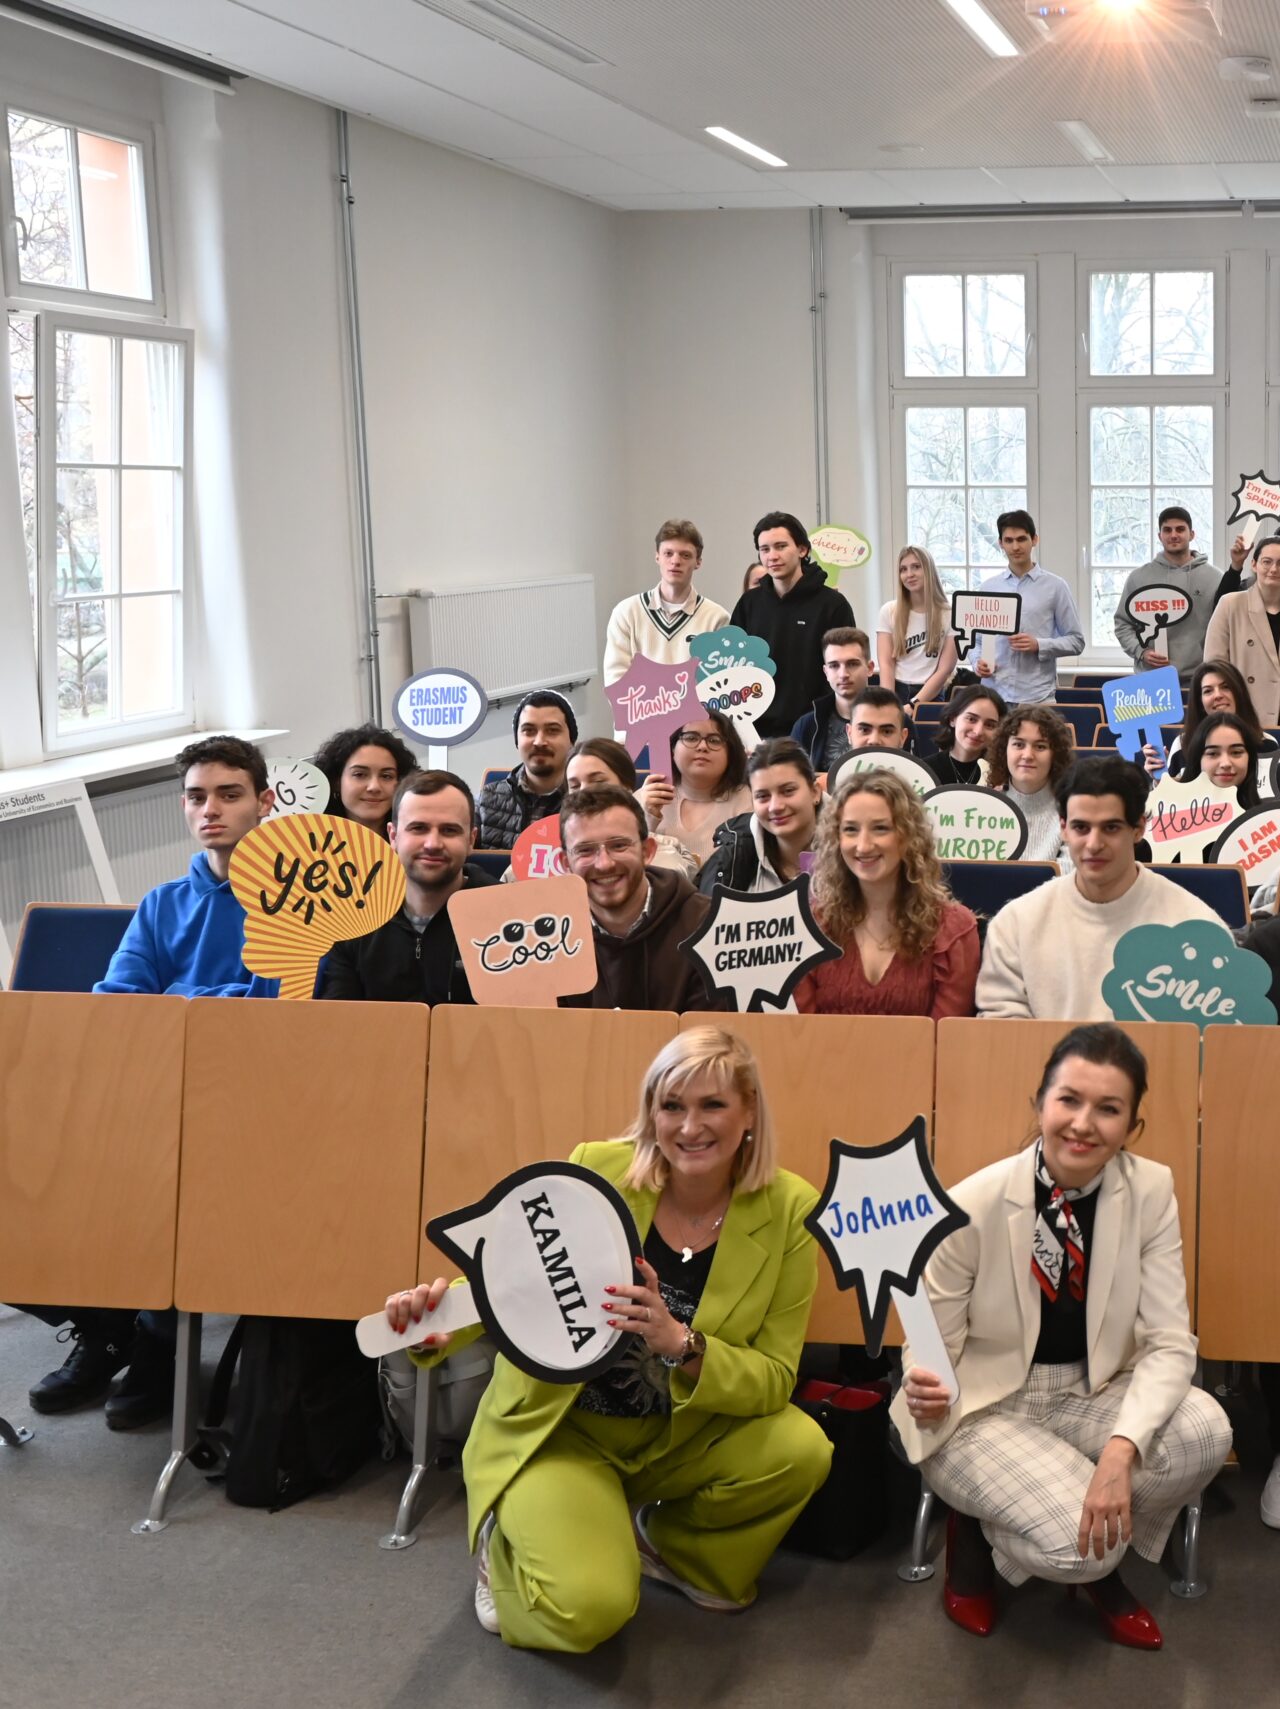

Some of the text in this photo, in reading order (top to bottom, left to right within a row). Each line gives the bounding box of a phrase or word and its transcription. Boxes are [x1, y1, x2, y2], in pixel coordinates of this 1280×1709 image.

[1246, 492, 1279, 511] SPAIN!
[812, 537, 847, 554] cheers
[974, 597, 1000, 612] HELLO
[1135, 600, 1168, 612] KISS
[964, 613, 1009, 629] POLAND!!!
[409, 686, 467, 706] ERASMUS
[700, 683, 762, 711] OOOPS
[1111, 688, 1152, 714] Really
[412, 706, 464, 726] STUDENT
[10, 793, 45, 807] Students
[964, 807, 1015, 830] From
[1148, 797, 1227, 840] Hello
[1238, 820, 1278, 852] I AM
[937, 837, 1007, 860] UROPE
[714, 915, 795, 946] I'M FROM
[473, 916, 580, 972] Cool
[715, 941, 803, 972] GERMANY!
[1136, 964, 1236, 1017] Smile
[828, 1194, 934, 1238] JoAnna
[520, 1191, 597, 1353] KAMILA
